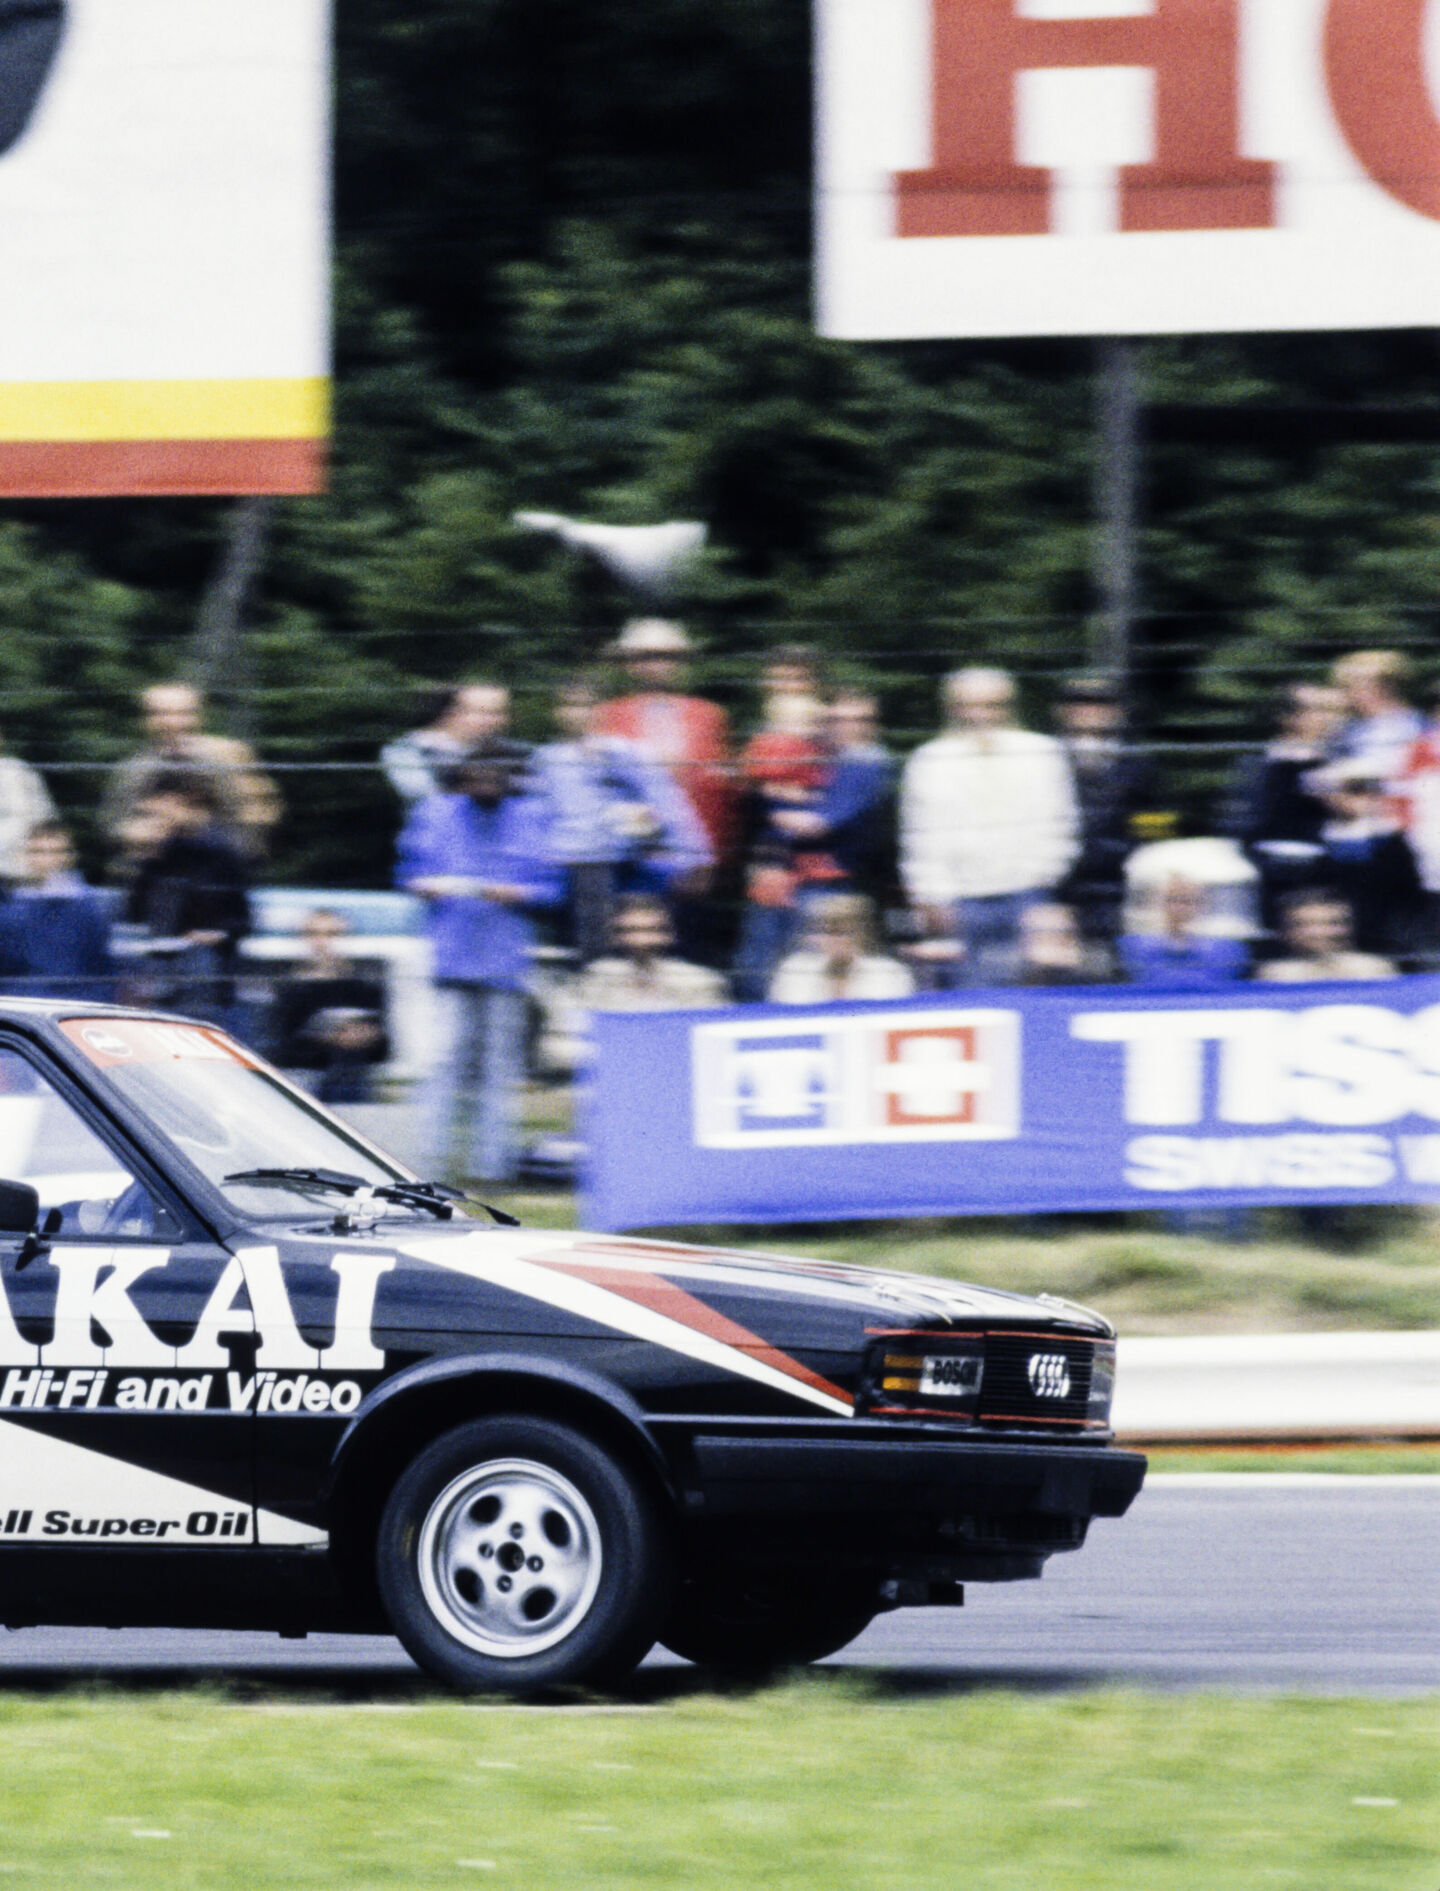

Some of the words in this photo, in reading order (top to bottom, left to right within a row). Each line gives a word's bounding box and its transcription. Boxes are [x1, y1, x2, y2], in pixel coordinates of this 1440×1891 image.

[876, 0, 1440, 238] H
[1069, 1002, 1440, 1126] TIS
[115, 1374, 215, 1411] and
[227, 1372, 363, 1414] Video
[42, 1510, 181, 1538] Super
[186, 1511, 250, 1538] Oil
